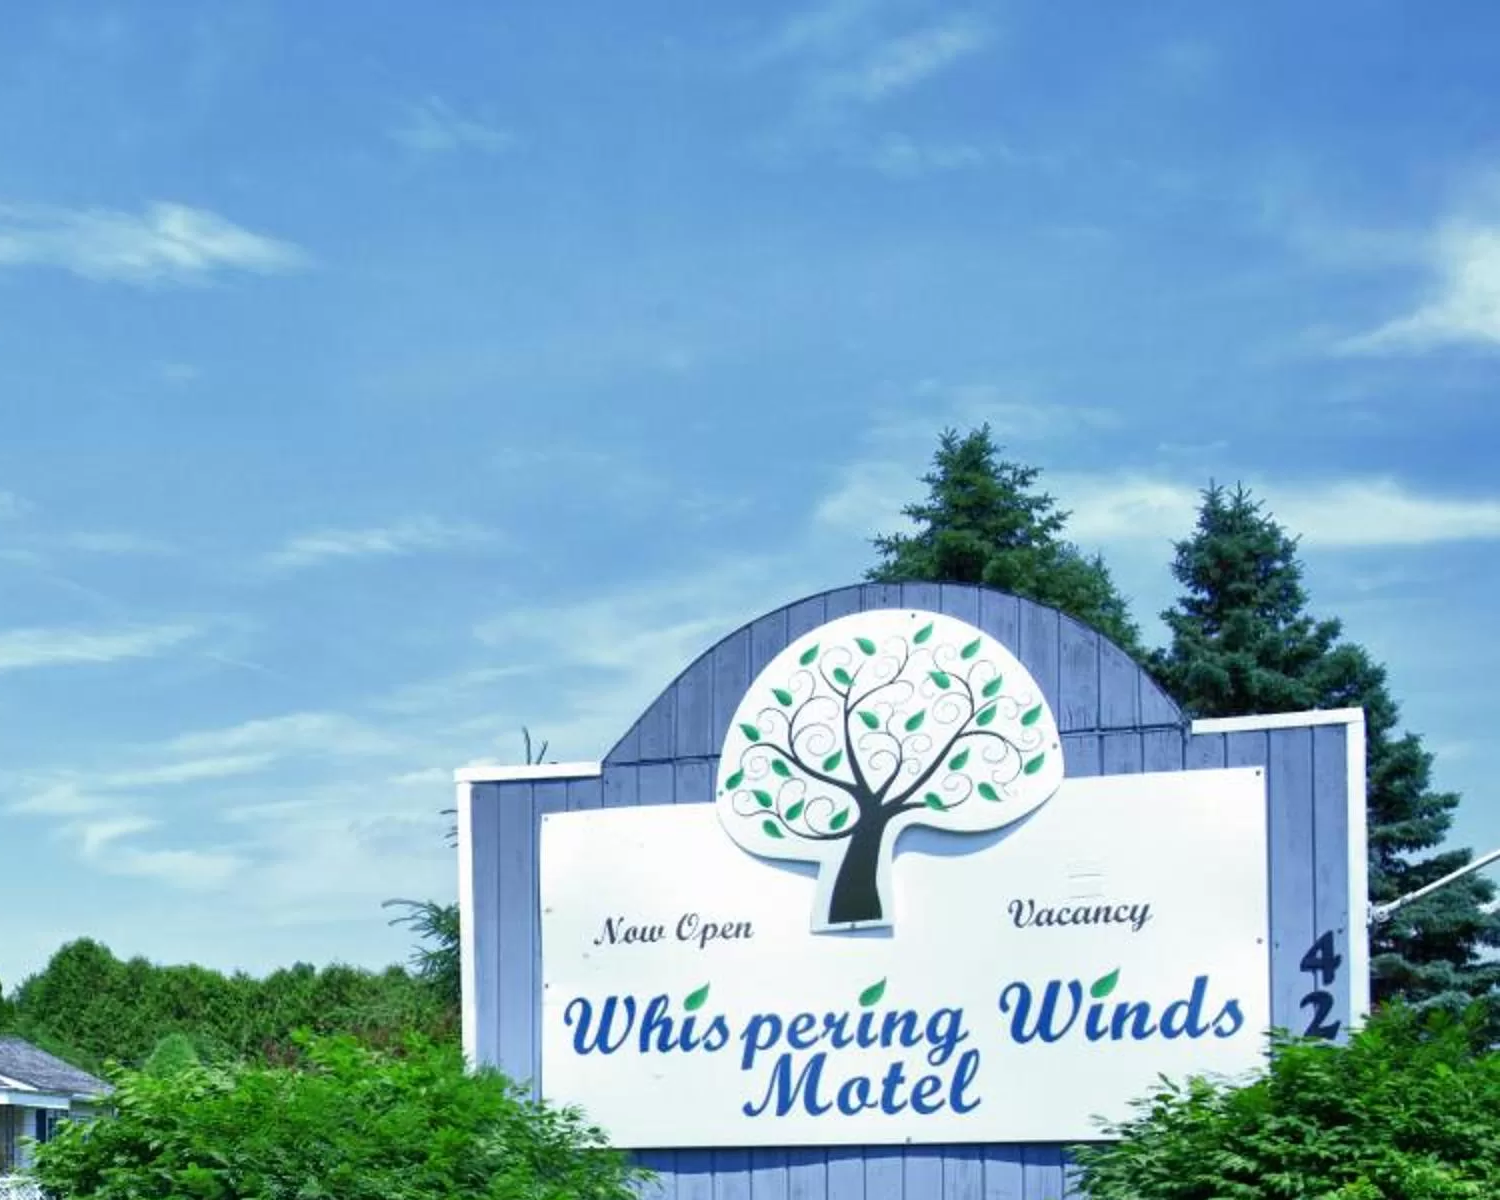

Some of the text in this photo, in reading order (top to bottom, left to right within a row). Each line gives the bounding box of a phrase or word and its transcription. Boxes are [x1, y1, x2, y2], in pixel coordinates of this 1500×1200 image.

[593, 912, 754, 949] Now Open
[1007, 898, 1153, 932] Vacancy
[563, 967, 1245, 1071] Whispering Winds
[742, 1047, 982, 1118] Motel
